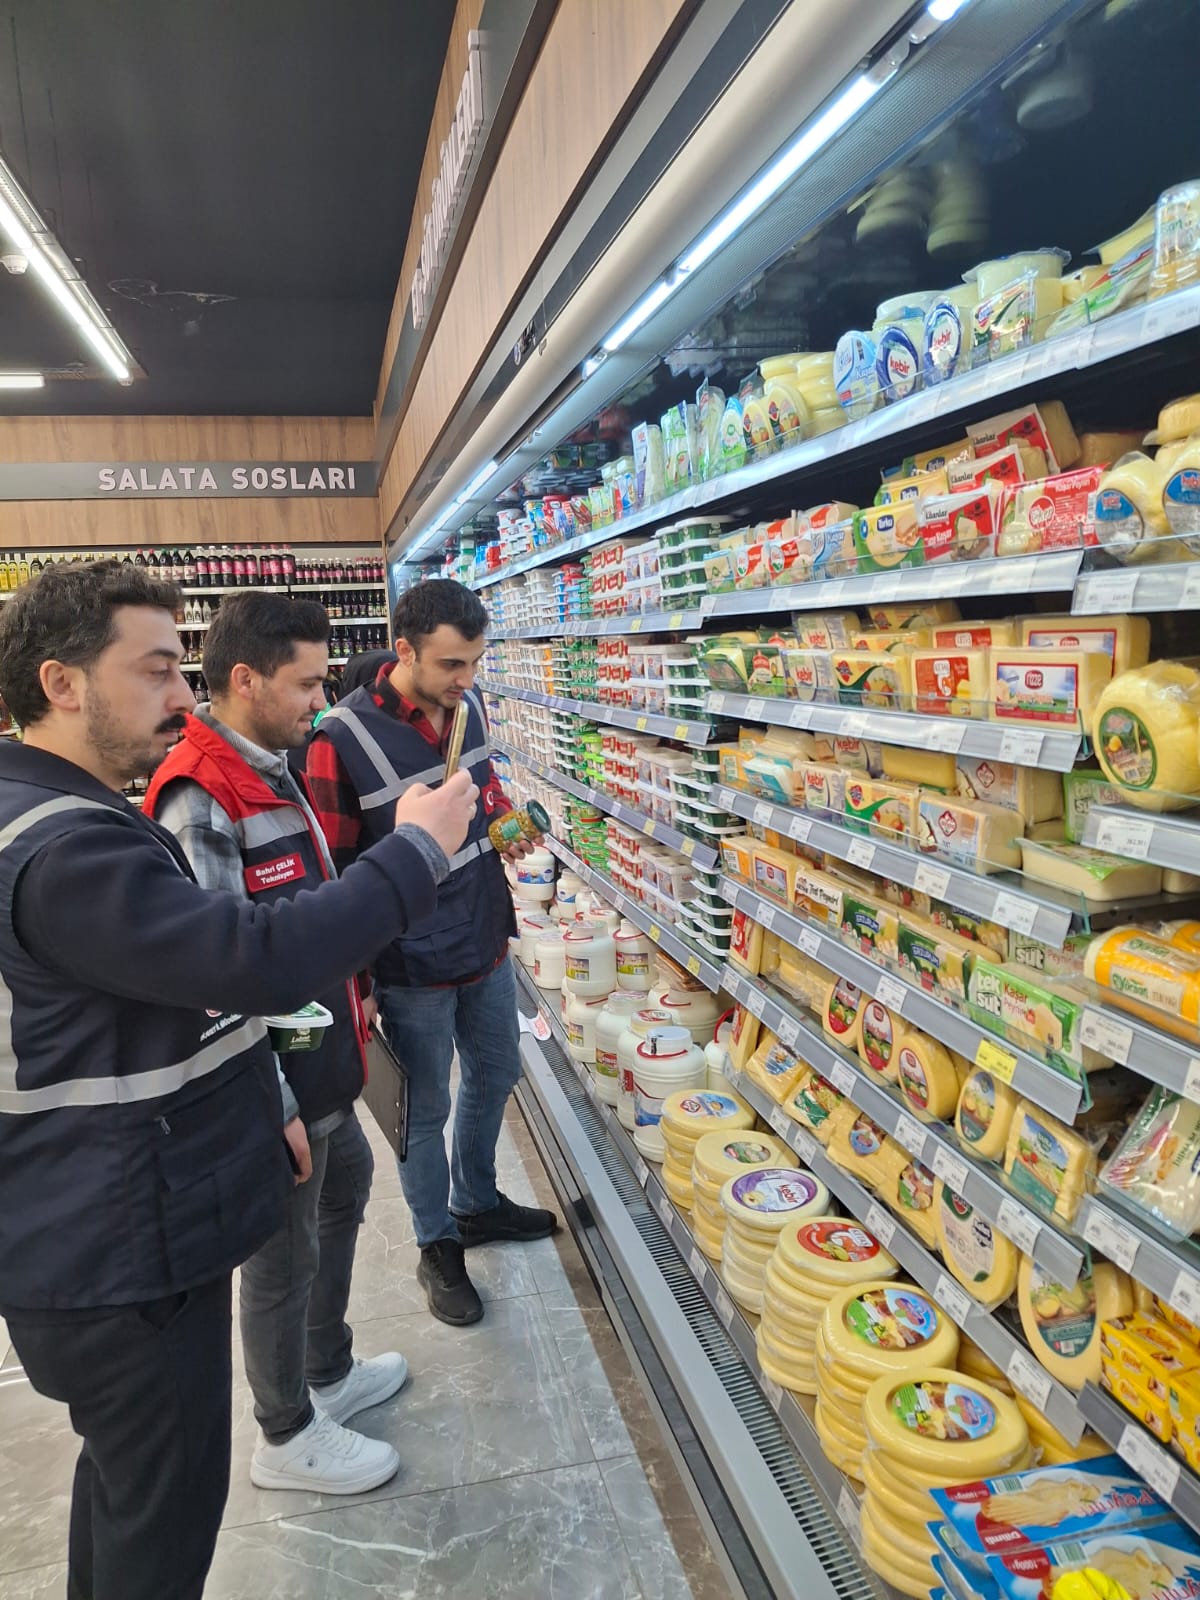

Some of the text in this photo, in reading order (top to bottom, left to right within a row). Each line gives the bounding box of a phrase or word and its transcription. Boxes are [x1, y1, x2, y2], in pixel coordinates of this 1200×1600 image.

[99, 467, 356, 491] SALATA SOSLARI
[275, 858, 295, 872] ÇELİK
[977, 971, 1000, 996] tek
[985, 1530, 1021, 1546] Dilimli
